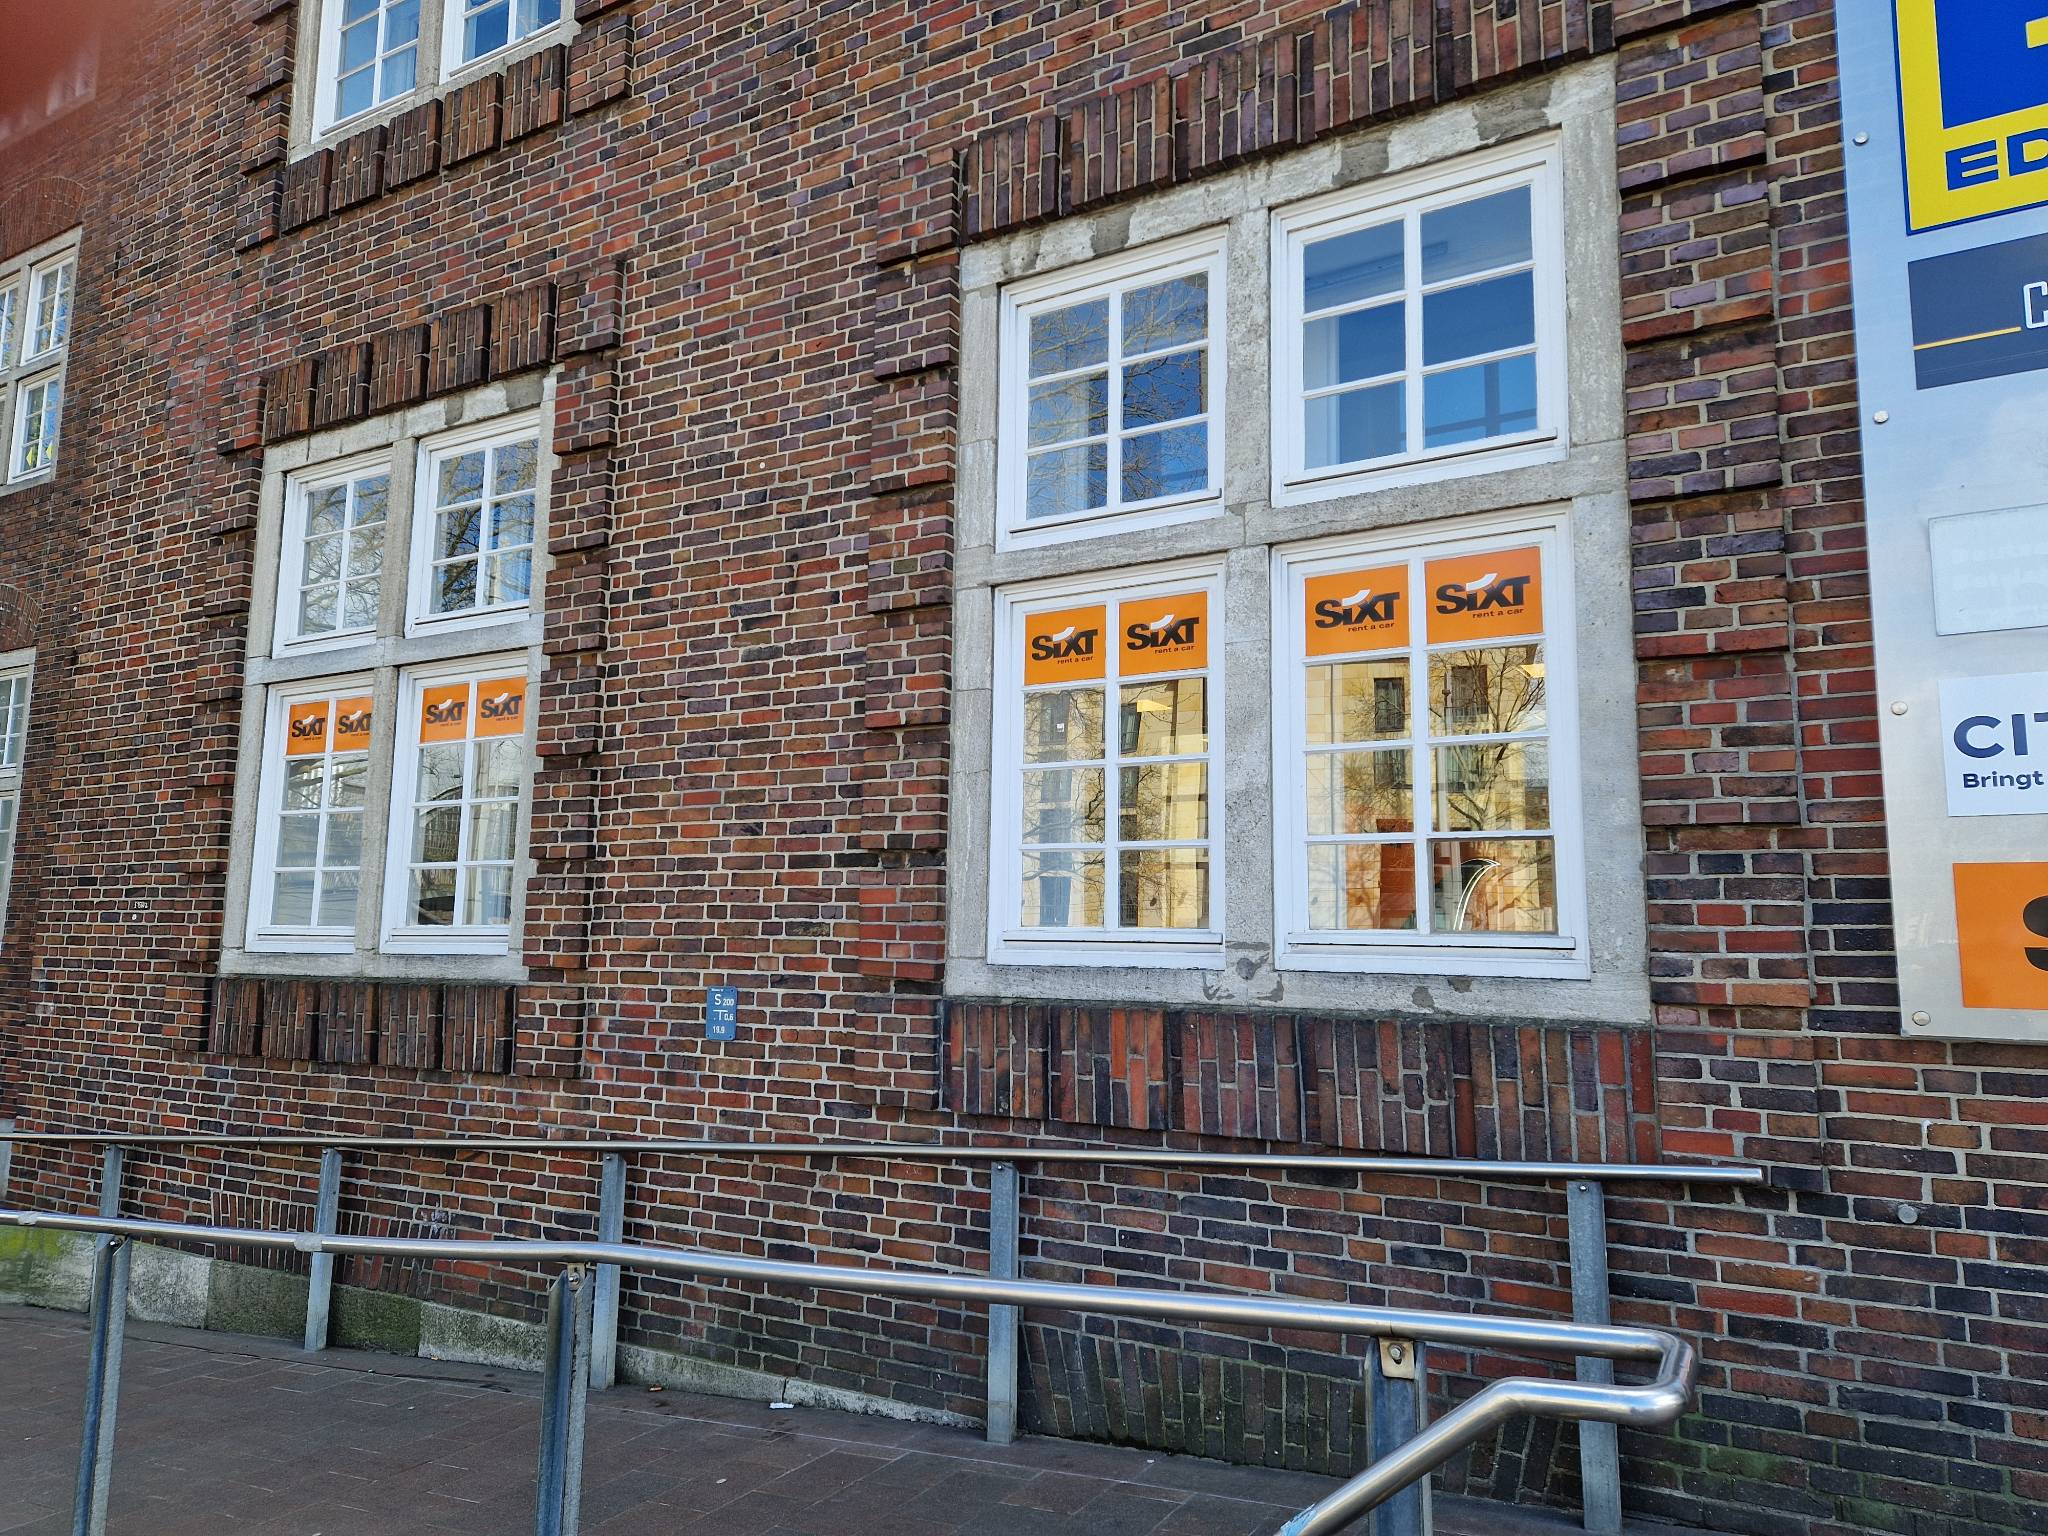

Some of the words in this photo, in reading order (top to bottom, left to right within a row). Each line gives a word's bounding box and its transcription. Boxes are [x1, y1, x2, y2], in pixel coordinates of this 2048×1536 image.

[1472, 610, 1494, 619] rent
[1506, 607, 1525, 615] car
[1347, 624, 1368, 633] rent
[1378, 621, 1395, 629] car
[1154, 647, 1172, 655] rent
[1181, 644, 1196, 652] car
[1056, 657, 1073, 665] rent
[1963, 770, 2045, 790] Bringt
[714, 993, 722, 1006] S
